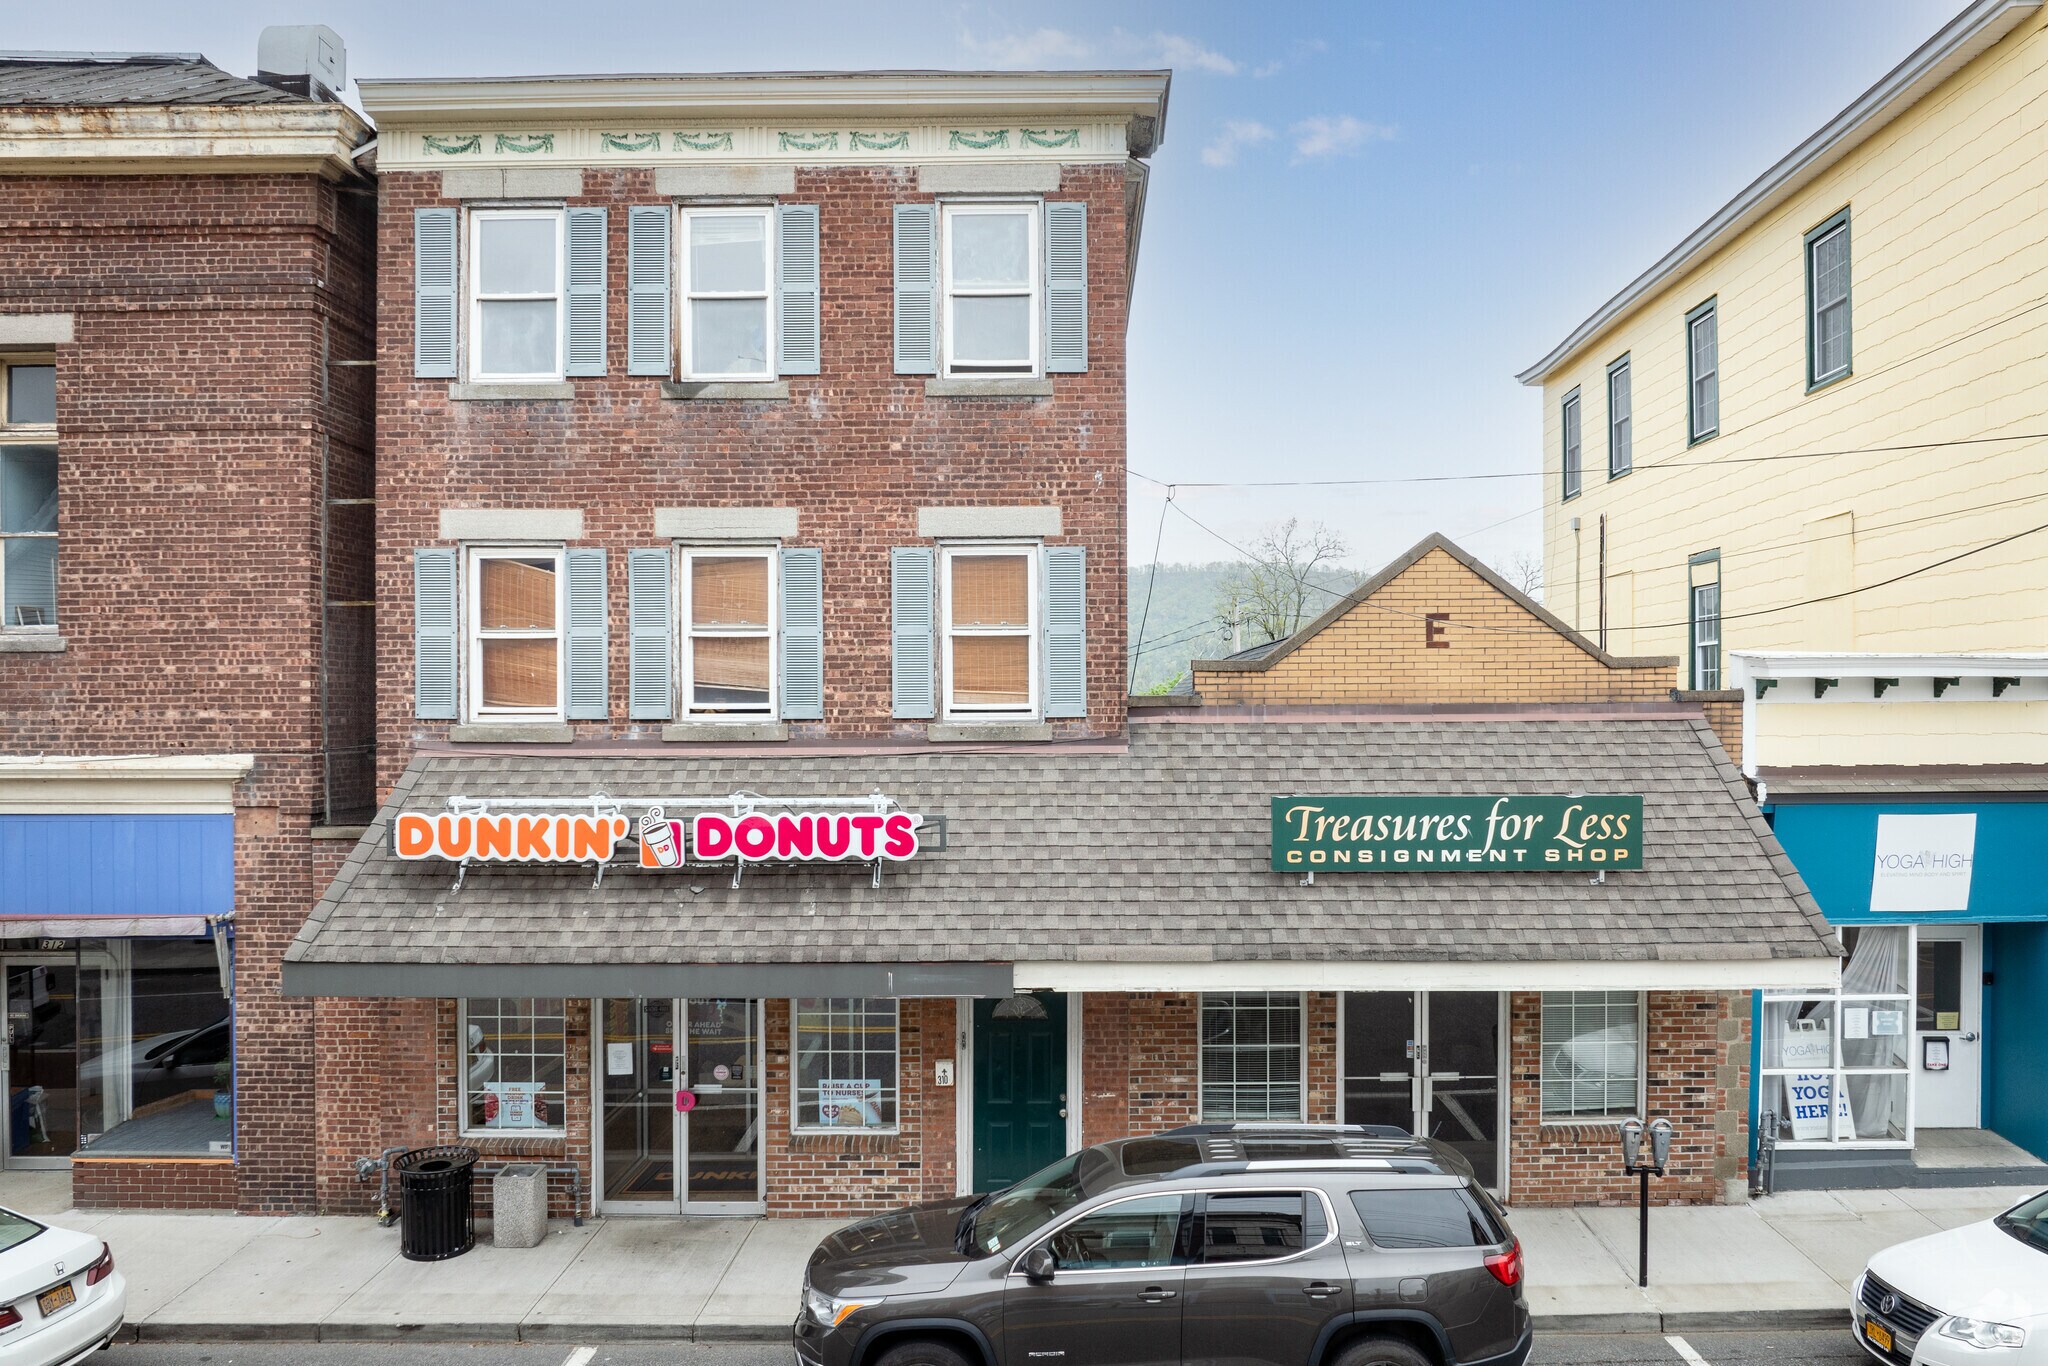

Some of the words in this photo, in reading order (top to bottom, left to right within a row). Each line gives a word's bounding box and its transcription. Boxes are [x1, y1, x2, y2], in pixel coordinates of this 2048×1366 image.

[1425, 612, 1450, 649] E
[1285, 805, 1472, 842] Treasures
[1482, 797, 1544, 856] for
[1553, 804, 1631, 848] Less
[398, 816, 626, 859] DUNKIN'
[697, 814, 915, 858] DONUTS
[1286, 848, 1528, 863] CONSIGNMENT
[1545, 848, 1630, 862] SHOP
[1877, 854, 1925, 869] YOGA
[1932, 853, 1973, 868] HIGH
[42, 940, 65, 950] 312
[694, 1021, 721, 1029] AHEAD
[1783, 1045, 1812, 1056] YOGA
[676, 1091, 696, 1112] D
